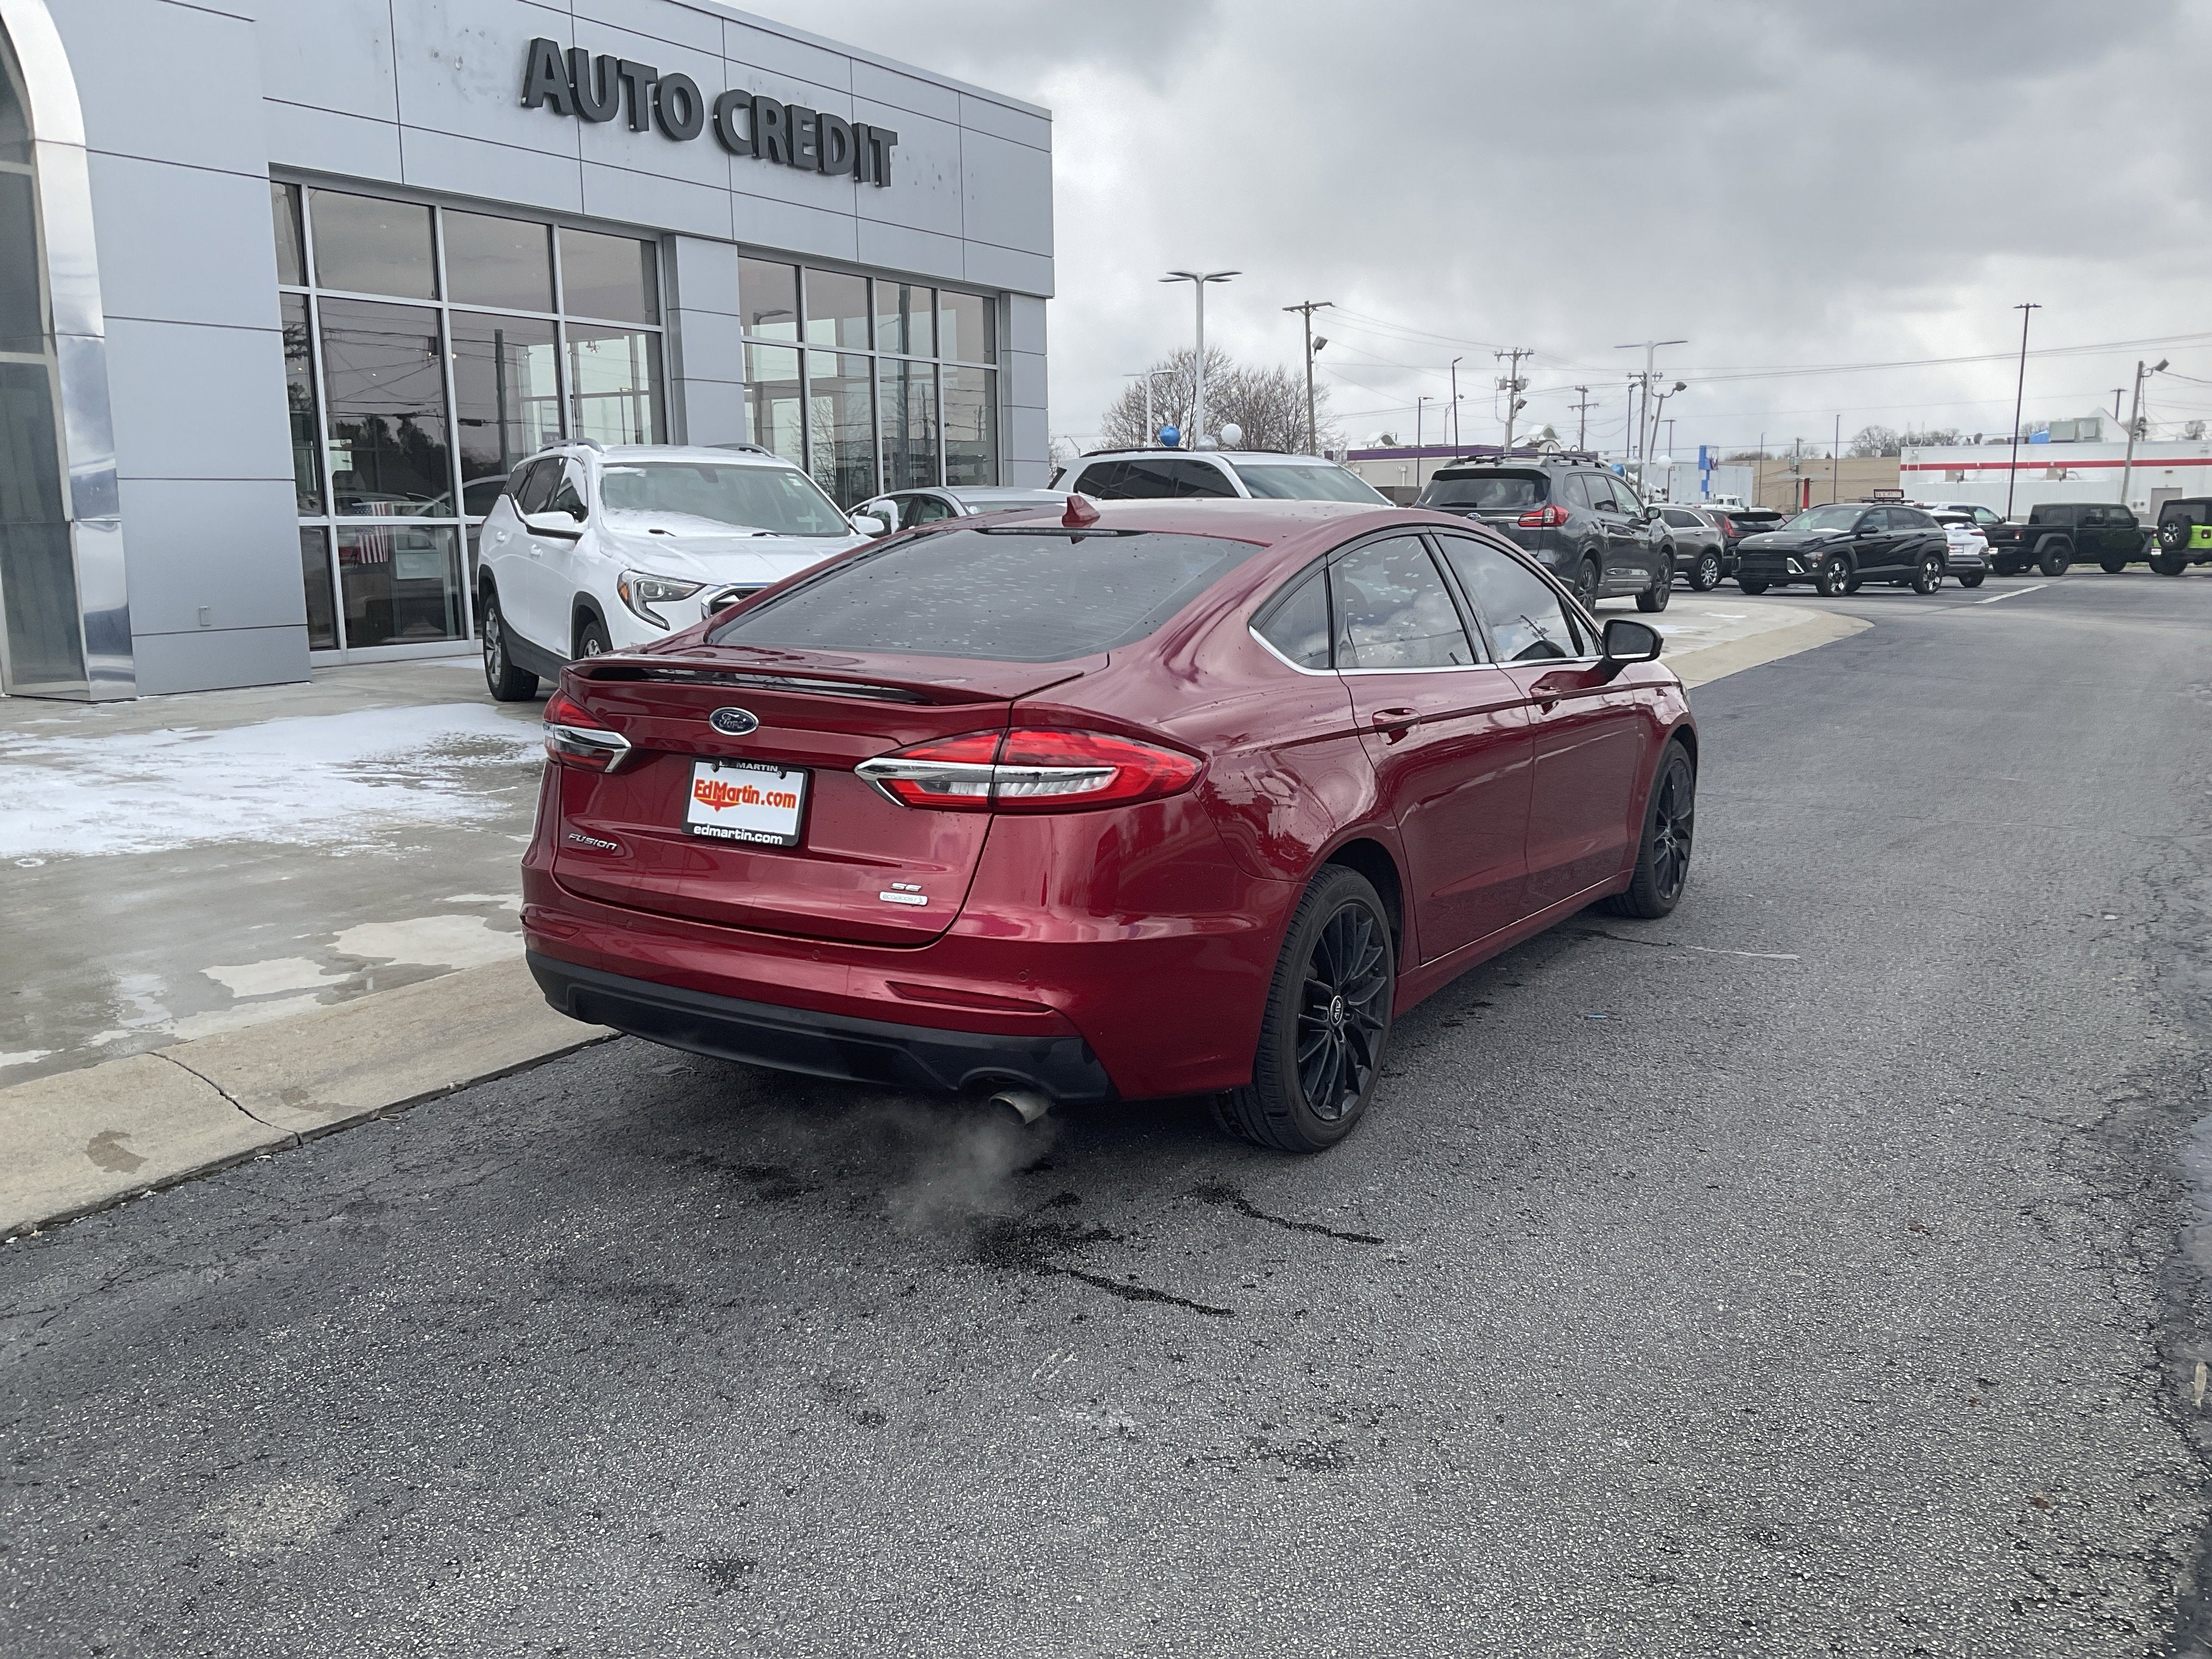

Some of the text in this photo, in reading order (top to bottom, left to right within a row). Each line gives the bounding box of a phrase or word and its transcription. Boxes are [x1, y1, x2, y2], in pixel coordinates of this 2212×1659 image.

[521, 37, 898, 187] AUTO CREDIT
[718, 713, 747, 730] Ford
[736, 762, 778, 772] MARTIN
[693, 778, 797, 809] EdMartin.com
[568, 833, 617, 850] FUSION
[693, 825, 783, 845] edmartin.com
[890, 883, 922, 892] SE
